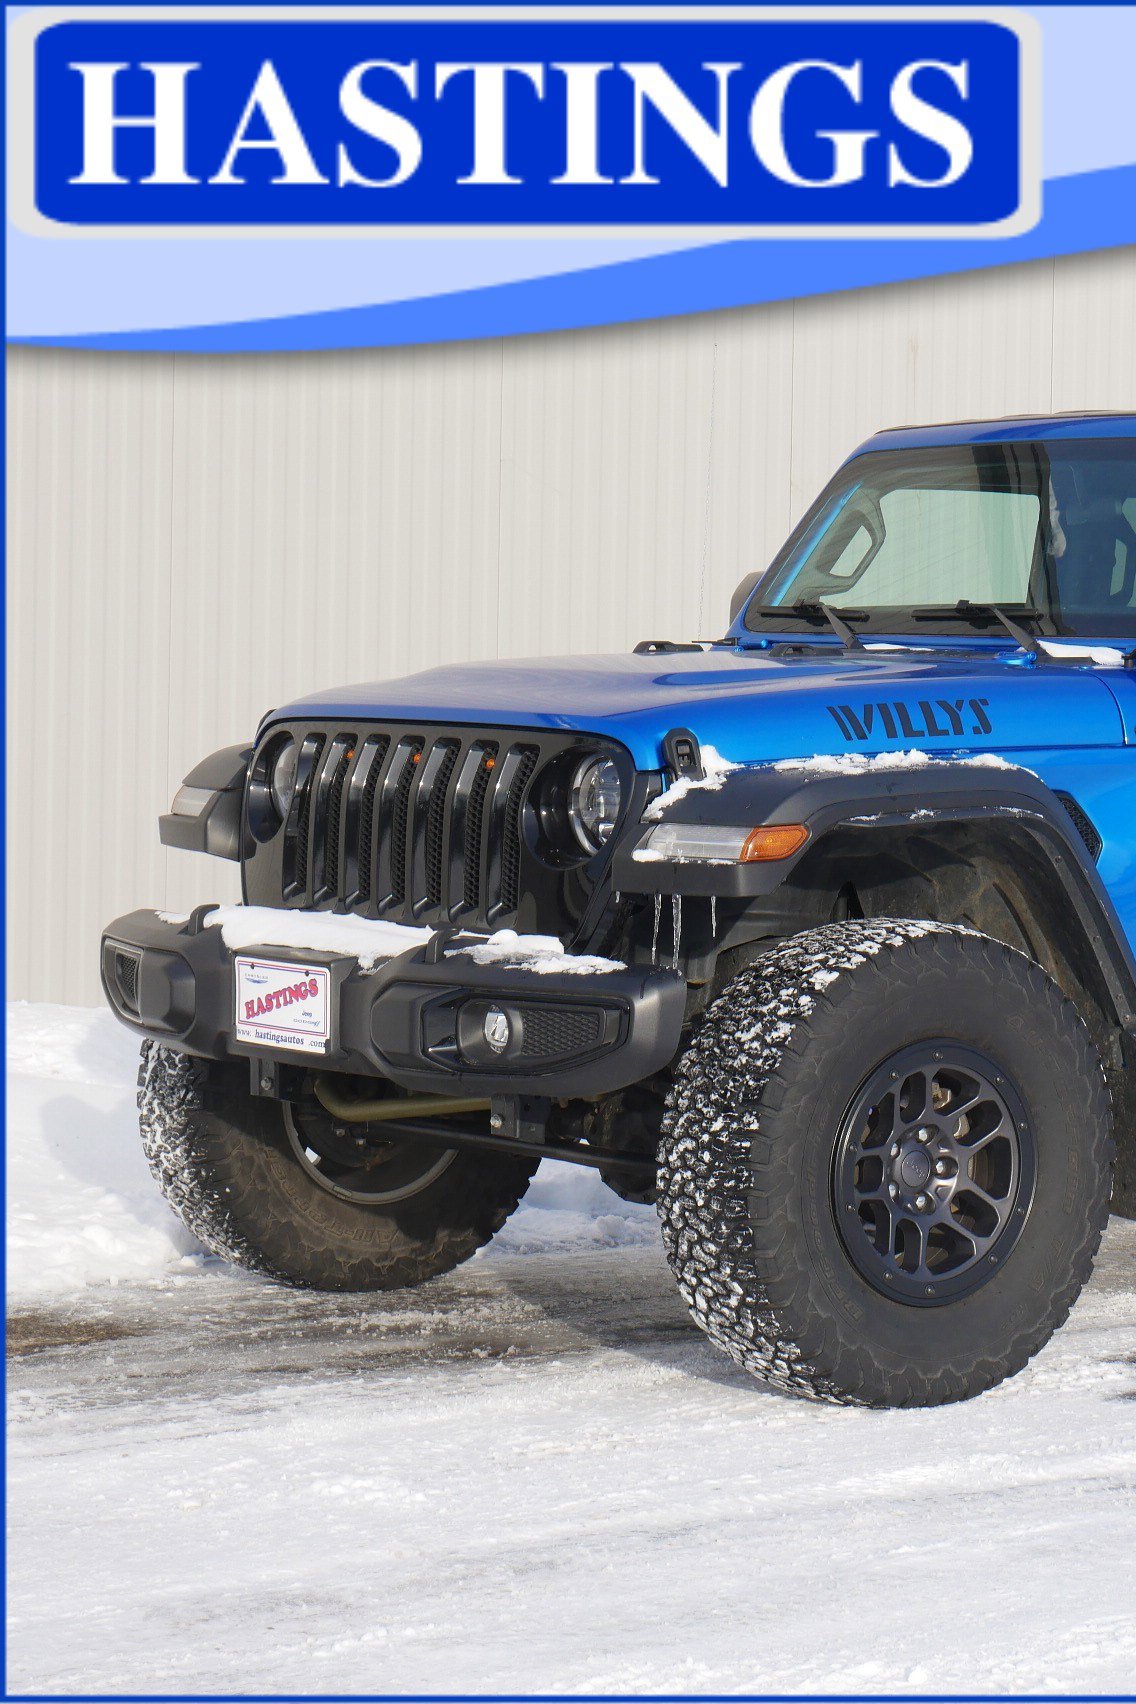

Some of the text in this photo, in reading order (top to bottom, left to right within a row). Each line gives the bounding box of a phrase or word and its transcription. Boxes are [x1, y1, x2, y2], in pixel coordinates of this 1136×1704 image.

[827, 698, 993, 742] WILLYS
[245, 978, 319, 1019] HASTINGS
[255, 1029, 304, 1045] hastingsautos
